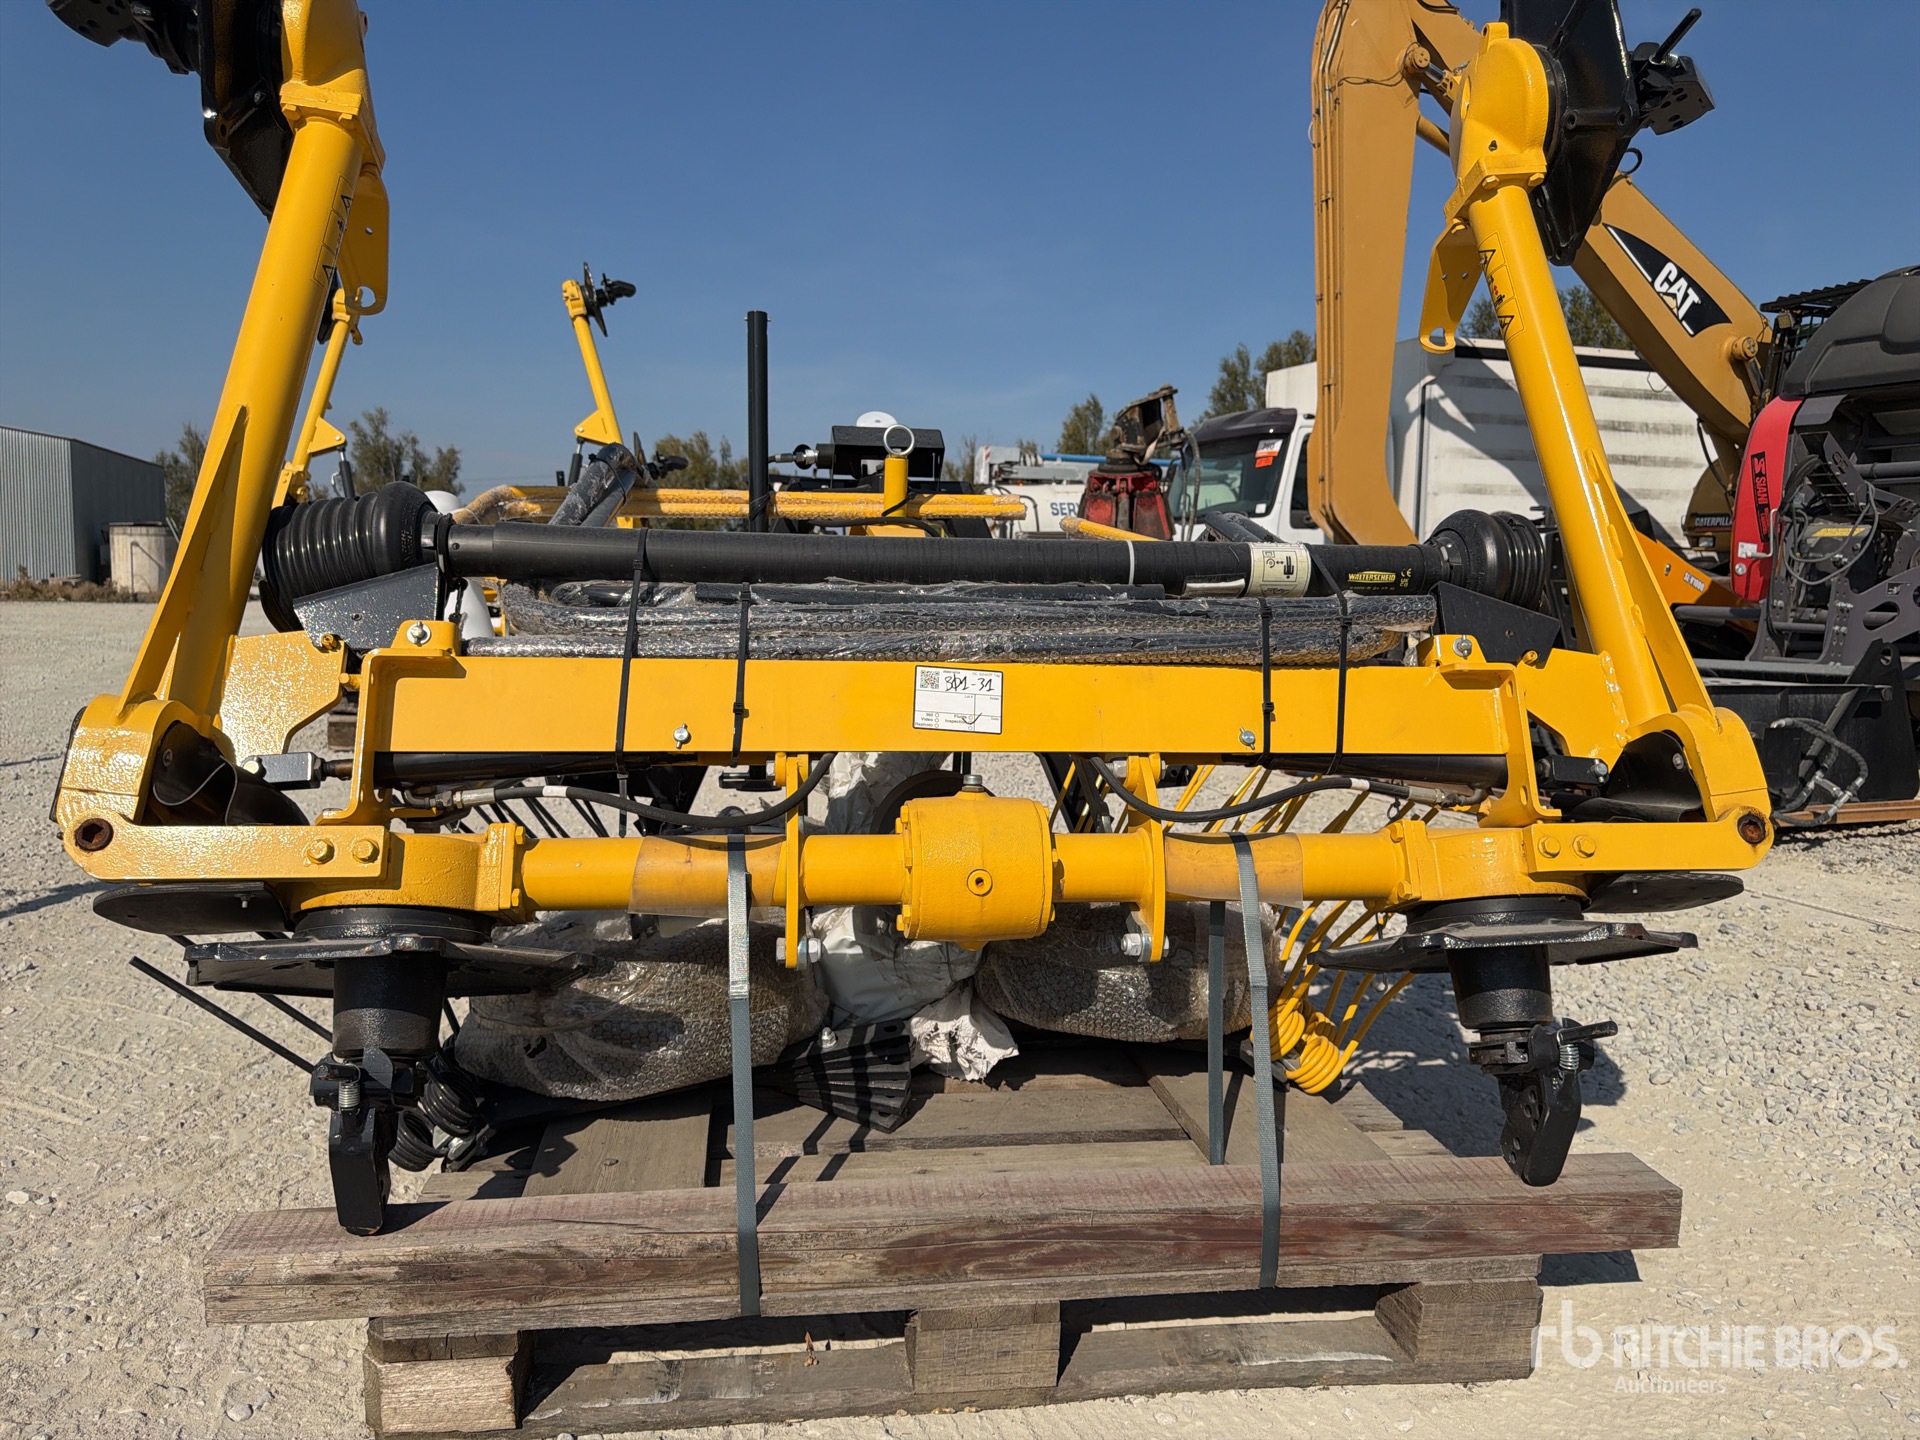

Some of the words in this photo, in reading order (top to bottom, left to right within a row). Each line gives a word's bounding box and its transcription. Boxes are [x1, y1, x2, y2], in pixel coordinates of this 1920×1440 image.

[1653, 261, 1701, 321] CAT
[1756, 476, 1769, 505] SIANI
[1348, 572, 1396, 582] WALTERSCHEID
